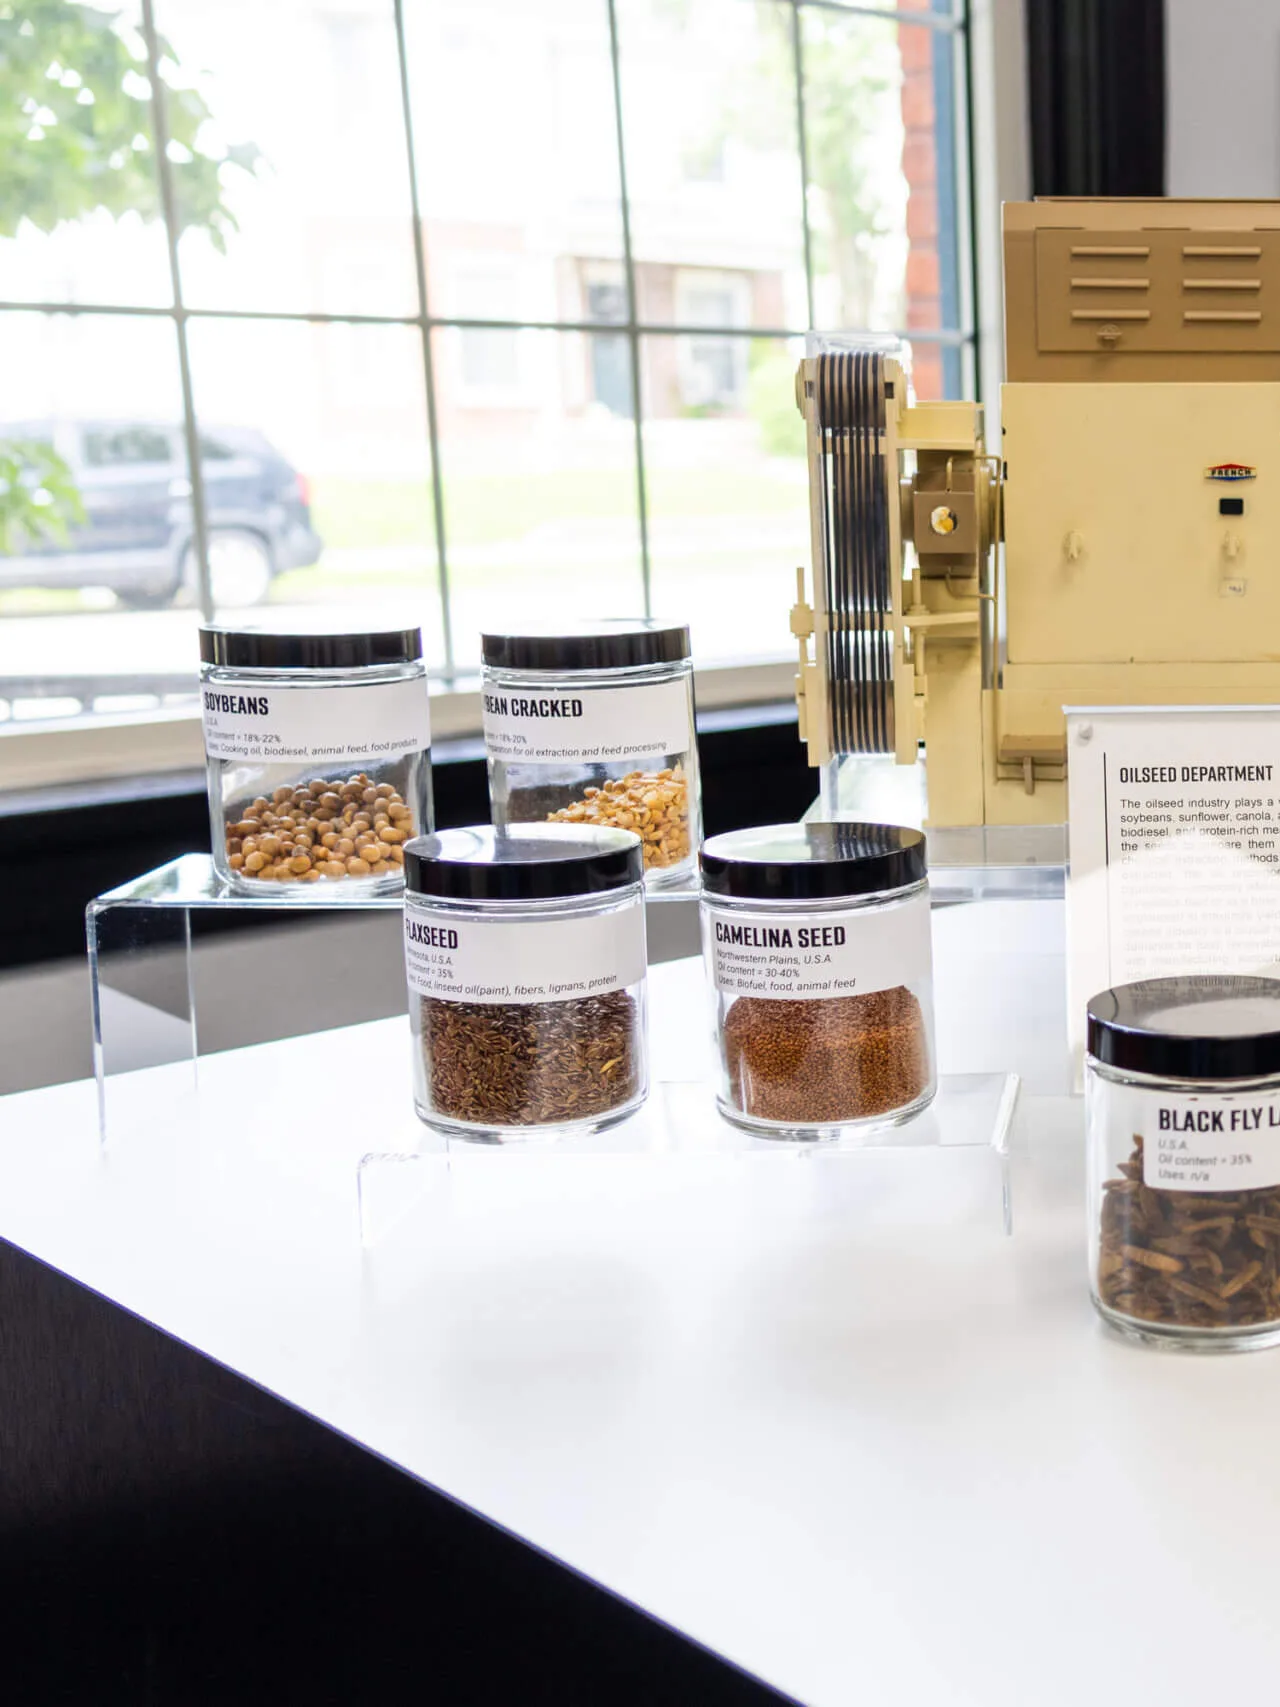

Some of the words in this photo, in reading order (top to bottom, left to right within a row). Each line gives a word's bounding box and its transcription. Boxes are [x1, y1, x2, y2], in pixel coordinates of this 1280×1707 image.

[205, 692, 269, 715] SOYBEANS
[511, 699, 583, 717] CRACKED
[221, 744, 248, 756] Cooking
[264, 747, 309, 756] biodiesel,
[311, 746, 344, 756] animal
[347, 743, 369, 754] feed,
[371, 741, 389, 752] food
[391, 737, 418, 750] products
[513, 747, 524, 756] for
[525, 747, 534, 756] oil
[536, 747, 579, 757] extraction
[582, 747, 599, 756] and
[601, 745, 621, 755] feed
[623, 741, 666, 755] processing
[1120, 767, 1177, 783] OILSEED
[1182, 765, 1273, 782] DEPARTMENT
[1120, 798, 1141, 809] The
[1146, 798, 1183, 809] oilseed
[1188, 797, 1230, 810] industry
[1235, 796, 1262, 809] plays
[1268, 798, 1274, 807] a
[1121, 812, 1175, 825] soybeans,
[1179, 811, 1232, 824] sunflower,
[1236, 810, 1273, 823] canola,
[1248, 838, 1274, 848] them
[716, 922, 793, 948] CAMELINA
[798, 926, 845, 947] SEED
[717, 950, 767, 964] Northwestern
[769, 955, 800, 965] Plains,
[437, 969, 454, 979] 35%
[718, 962, 726, 971] Oil
[727, 965, 755, 976] content
[765, 968, 799, 977] 30-40%
[434, 979, 462, 993] linseed
[549, 981, 586, 994] lignans,
[588, 974, 617, 990] protein
[737, 978, 767, 991] Biofuel,
[770, 981, 794, 991] food,
[797, 980, 831, 991] animal
[834, 978, 856, 988] feed
[1159, 1108, 1224, 1132] BLACK
[1231, 1107, 1263, 1130] FLY
[1158, 1153, 1172, 1164] Oil
[1175, 1155, 1217, 1166] content
[1230, 1154, 1252, 1165] 35%
[1191, 1171, 1210, 1181] n/a
